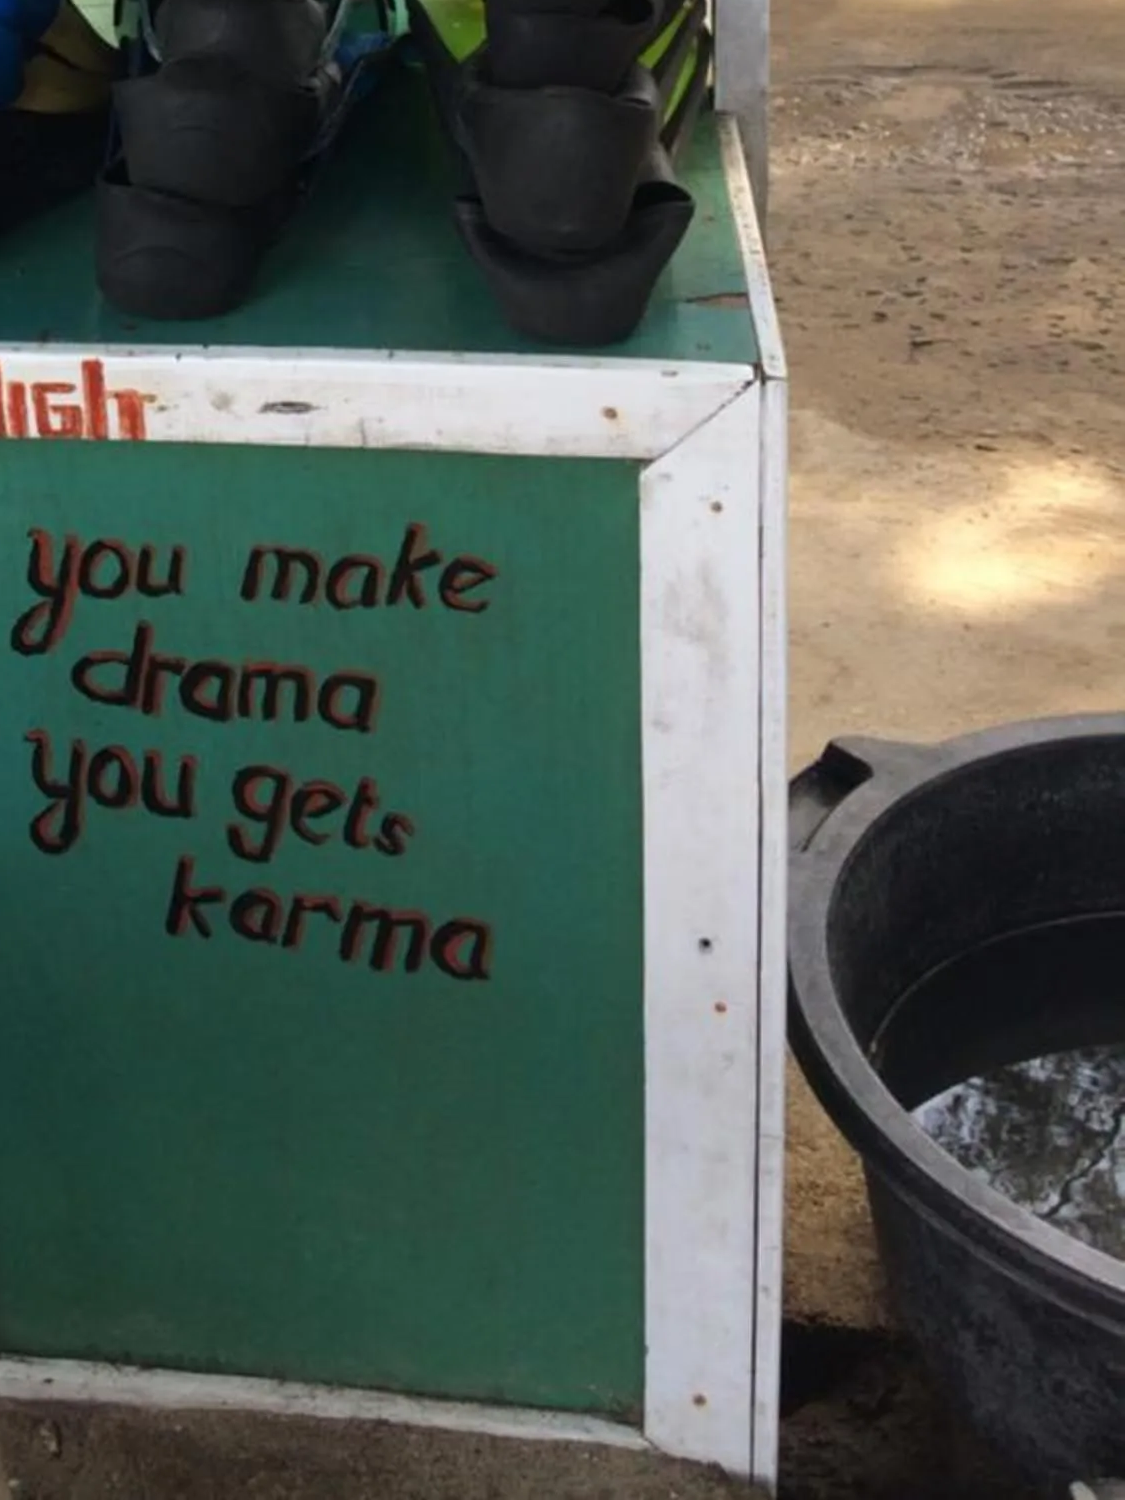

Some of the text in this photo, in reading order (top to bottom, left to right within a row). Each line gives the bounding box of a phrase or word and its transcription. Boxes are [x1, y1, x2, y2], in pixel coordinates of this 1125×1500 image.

[10, 522, 498, 656] you make
[71, 620, 382, 734] drama
[23, 728, 416, 864] you gets
[165, 854, 493, 982] karma
